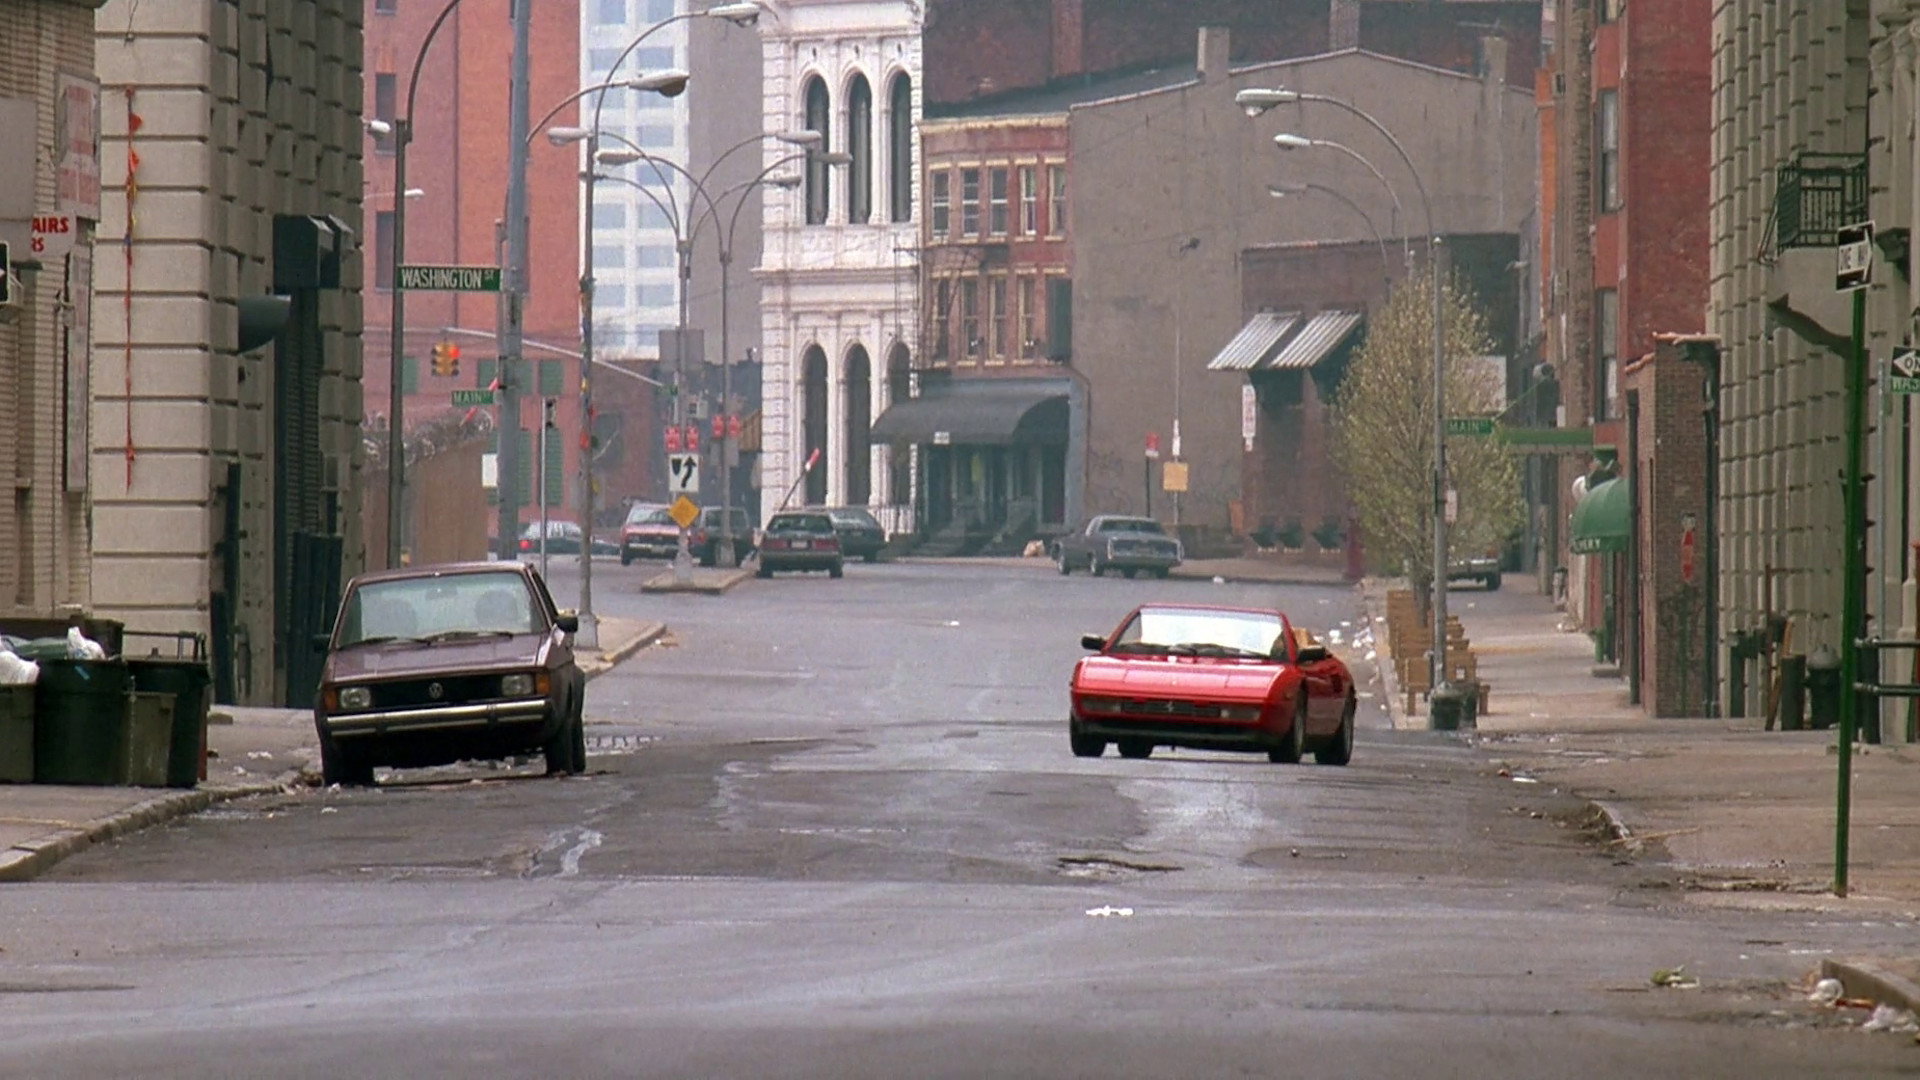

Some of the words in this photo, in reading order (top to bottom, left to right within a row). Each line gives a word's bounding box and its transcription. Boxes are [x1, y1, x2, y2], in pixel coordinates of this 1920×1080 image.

[402, 268, 482, 288] WASHINGTON
[453, 391, 482, 403] MAIN
[1450, 420, 1479, 432] MAIN
